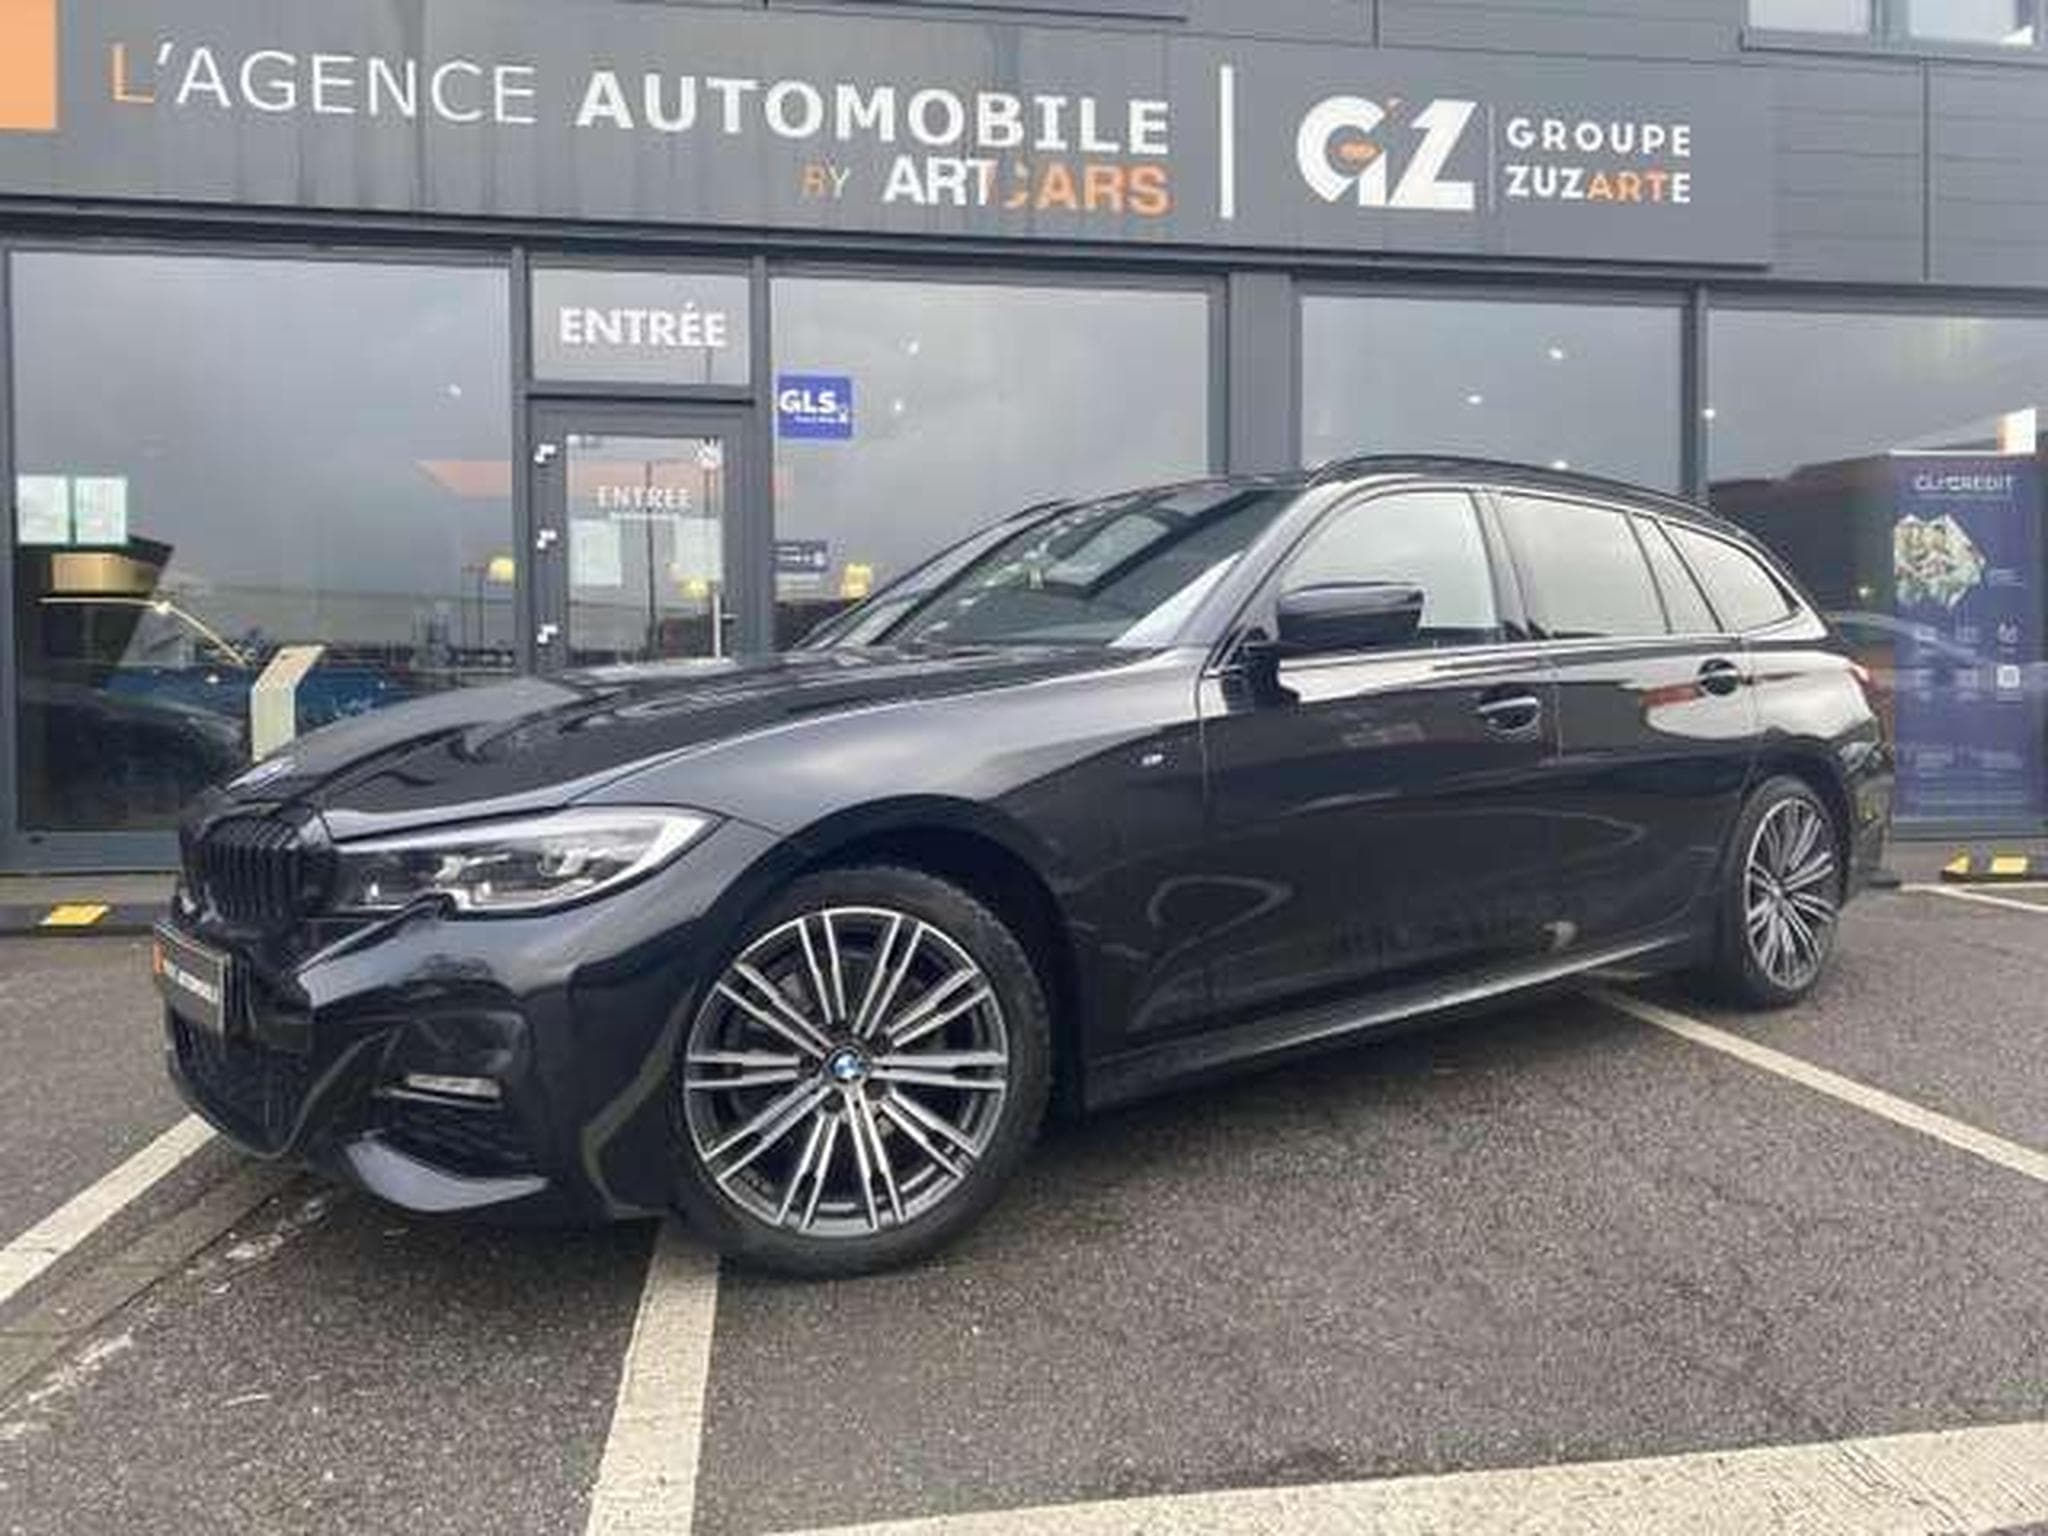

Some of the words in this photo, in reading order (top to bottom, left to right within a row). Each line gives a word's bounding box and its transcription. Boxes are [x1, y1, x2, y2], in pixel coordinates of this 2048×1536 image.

[113, 42, 537, 123] L'AGENCE
[575, 71, 1170, 154] AUTOMOBILE
[1506, 118, 1691, 157] GROUPE
[803, 160, 850, 198] BY
[1506, 164, 1691, 204] ZUZARTE
[558, 301, 727, 347] ENTRÉE
[780, 389, 837, 414] GLS
